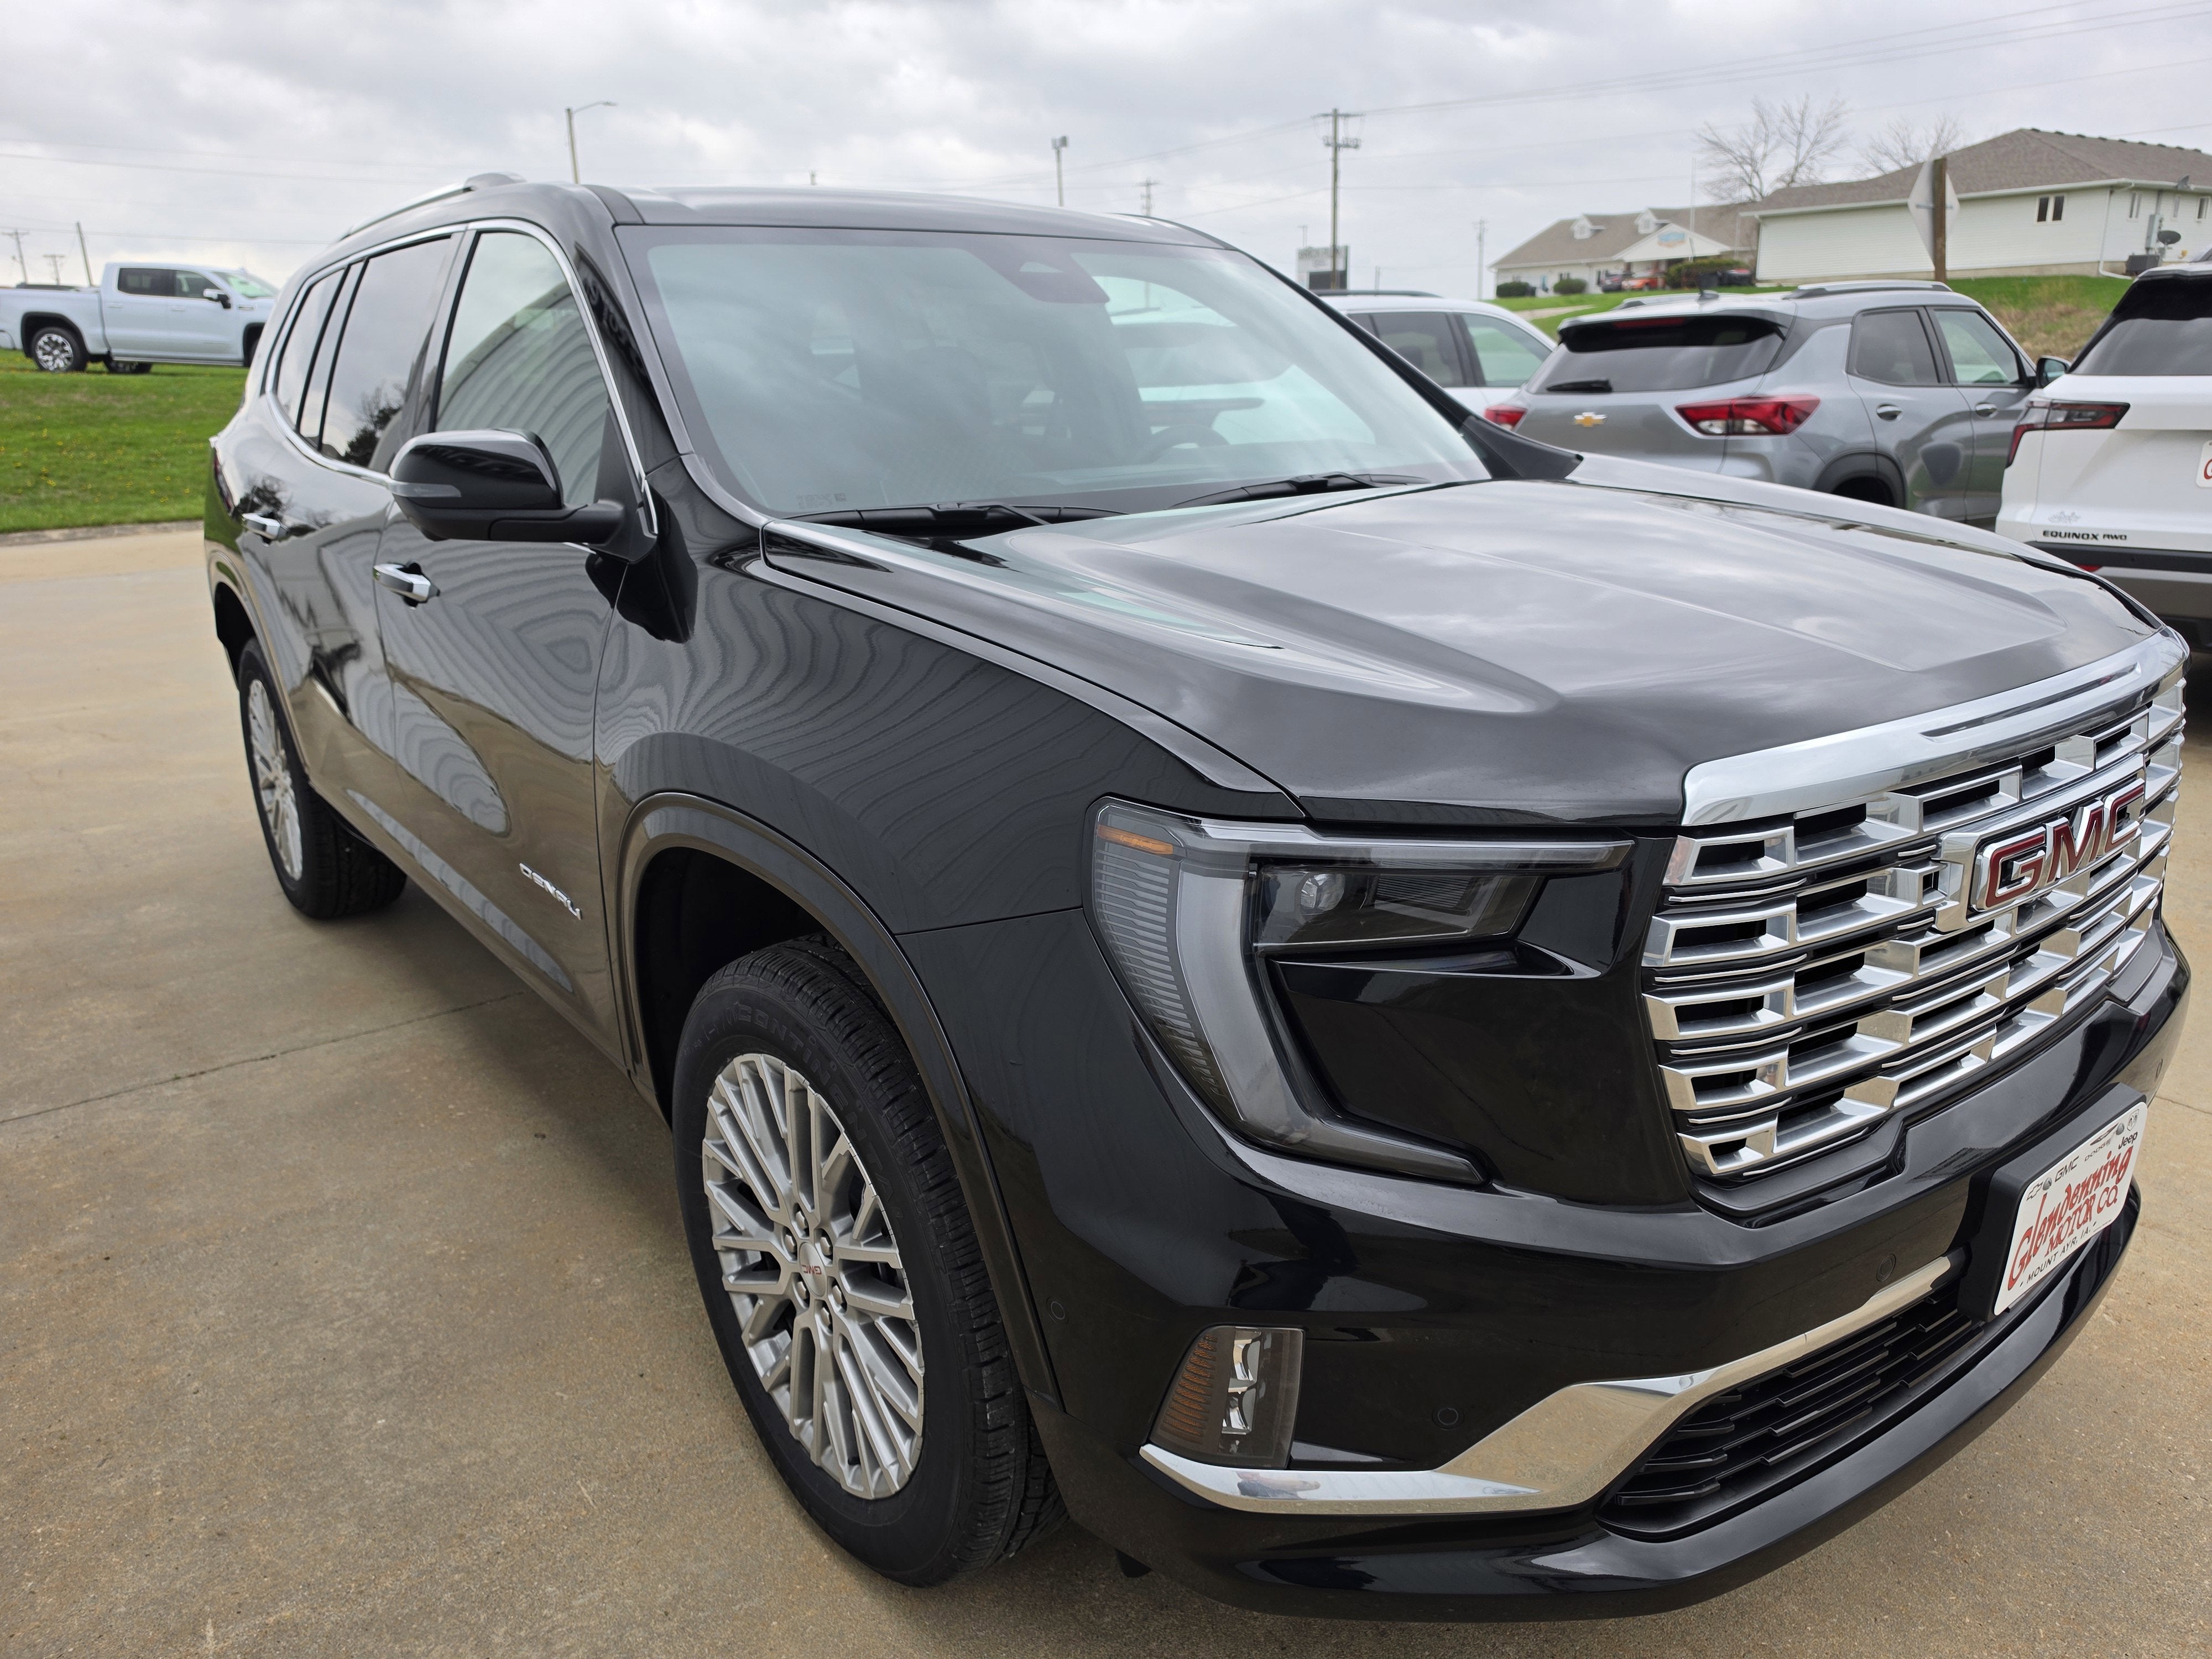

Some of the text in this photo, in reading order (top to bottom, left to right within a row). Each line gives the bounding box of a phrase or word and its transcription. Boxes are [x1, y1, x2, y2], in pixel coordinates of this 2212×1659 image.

[2043, 530, 2100, 540] EQUINOX
[1981, 778, 2145, 910] GMC
[738, 1004, 904, 1239] CONTINENTAL
[2118, 1131, 2138, 1150] Jeep
[2054, 1155, 2079, 1182] GMC
[2007, 1146, 2133, 1291] Glendenning
[2044, 1196, 2095, 1258] MOTOR
[801, 1264, 822, 1275] GMC
[2026, 1251, 2059, 1284] MOUNT
